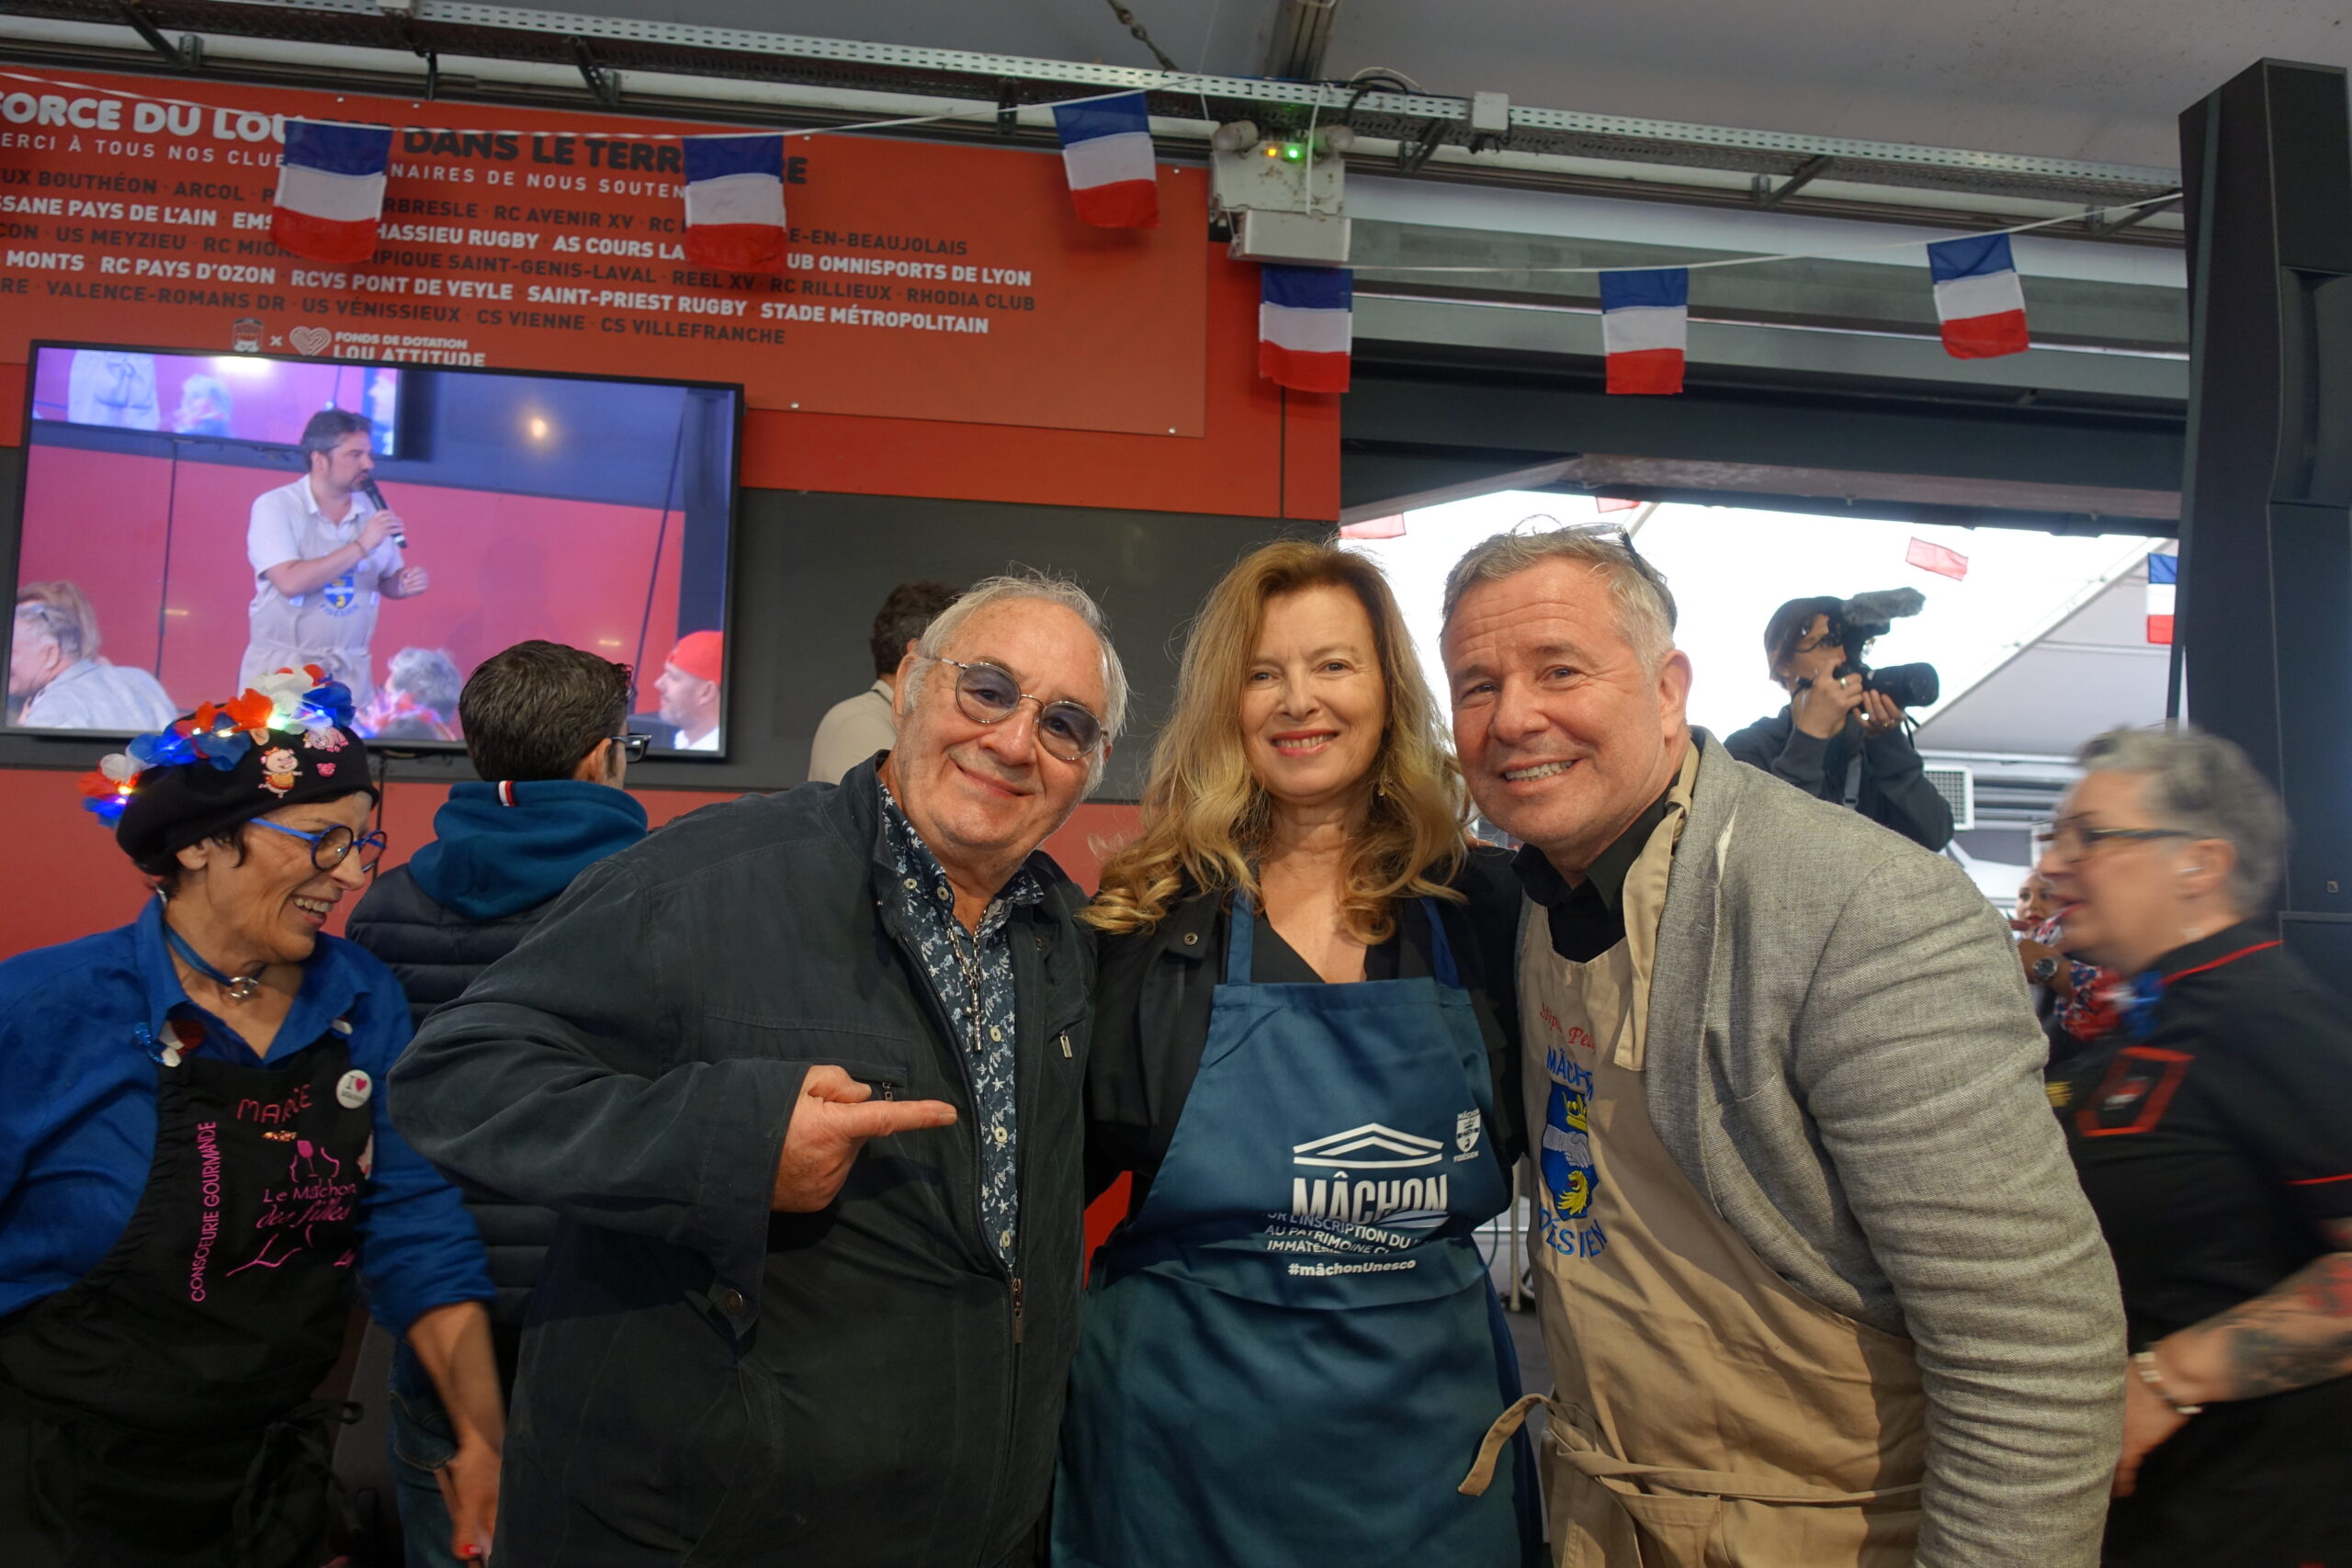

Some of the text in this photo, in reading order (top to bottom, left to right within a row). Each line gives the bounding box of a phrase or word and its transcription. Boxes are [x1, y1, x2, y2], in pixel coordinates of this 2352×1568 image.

[0, 90, 122, 130] ORCE
[133, 102, 201, 136] DU
[403, 126, 519, 161] DANS
[533, 135, 576, 166] LE
[0, 132, 685, 198] ERCI À TOUS NOS CLUB NAIRES DE NOUS SOUTEN
[0, 196, 62, 216] SANE
[68, 199, 124, 220] PAYS
[130, 204, 158, 222] DE
[164, 207, 217, 227] L'AIN
[377, 223, 463, 243] HASSIEU
[469, 229, 539, 249] RUGBY
[553, 235, 581, 253] AS
[585, 238, 654, 258] COURS
[786, 253, 814, 270] UB
[820, 255, 946, 281] OMNISPORTS
[952, 265, 977, 282] DE
[982, 267, 1031, 287] LYON
[1, 169, 31, 186] UX
[38, 171, 157, 195] BOUTHÉON
[174, 181, 244, 201] ARCOL
[382, 197, 479, 219] RBRESLE
[494, 205, 521, 221] RC
[526, 208, 602, 227] AVENIR
[607, 213, 634, 230] XV
[649, 217, 675, 232] RC
[788, 228, 967, 255] E-EN-BEAUJOLAIS
[0, 222, 39, 239] CON
[55, 227, 84, 243] US
[90, 230, 187, 249] MEYZIEU
[203, 237, 231, 253] RC
[371, 249, 442, 269] PIQUE
[448, 254, 656, 283] SAINT-GENIS-LAVAL
[672, 269, 724, 288] REEL
[729, 273, 757, 291] XV
[770, 277, 797, 293] RC
[801, 279, 892, 300] RILLIEUX
[907, 288, 979, 308] RHODIA
[985, 293, 1035, 311] CLUB
[6, 250, 989, 333] MONTS RC PAYS D'OZON RCVS PONT DE VEYLE SAINT-PRIEST RUGBY STADE MÉTROPOLITAIN
[0, 277, 786, 344] RE VALENCE-ROMANS DR US VÉNISSIEUX CS VIENNE CS VILLEFRANCHE
[335, 332, 380, 344] FONDS
[382, 334, 401, 345] DE
[402, 335, 468, 349] DOTATION
[334, 344, 485, 367] LOU ATTITUDE
[198, 1121, 220, 1207] GOURMANDE
[263, 1189, 288, 1202] Le
[1292, 1170, 1449, 1225] MÂCHON
[1288, 1259, 1417, 1276] #mâchonUnesco
[1389, 1233, 1411, 1249] DU
